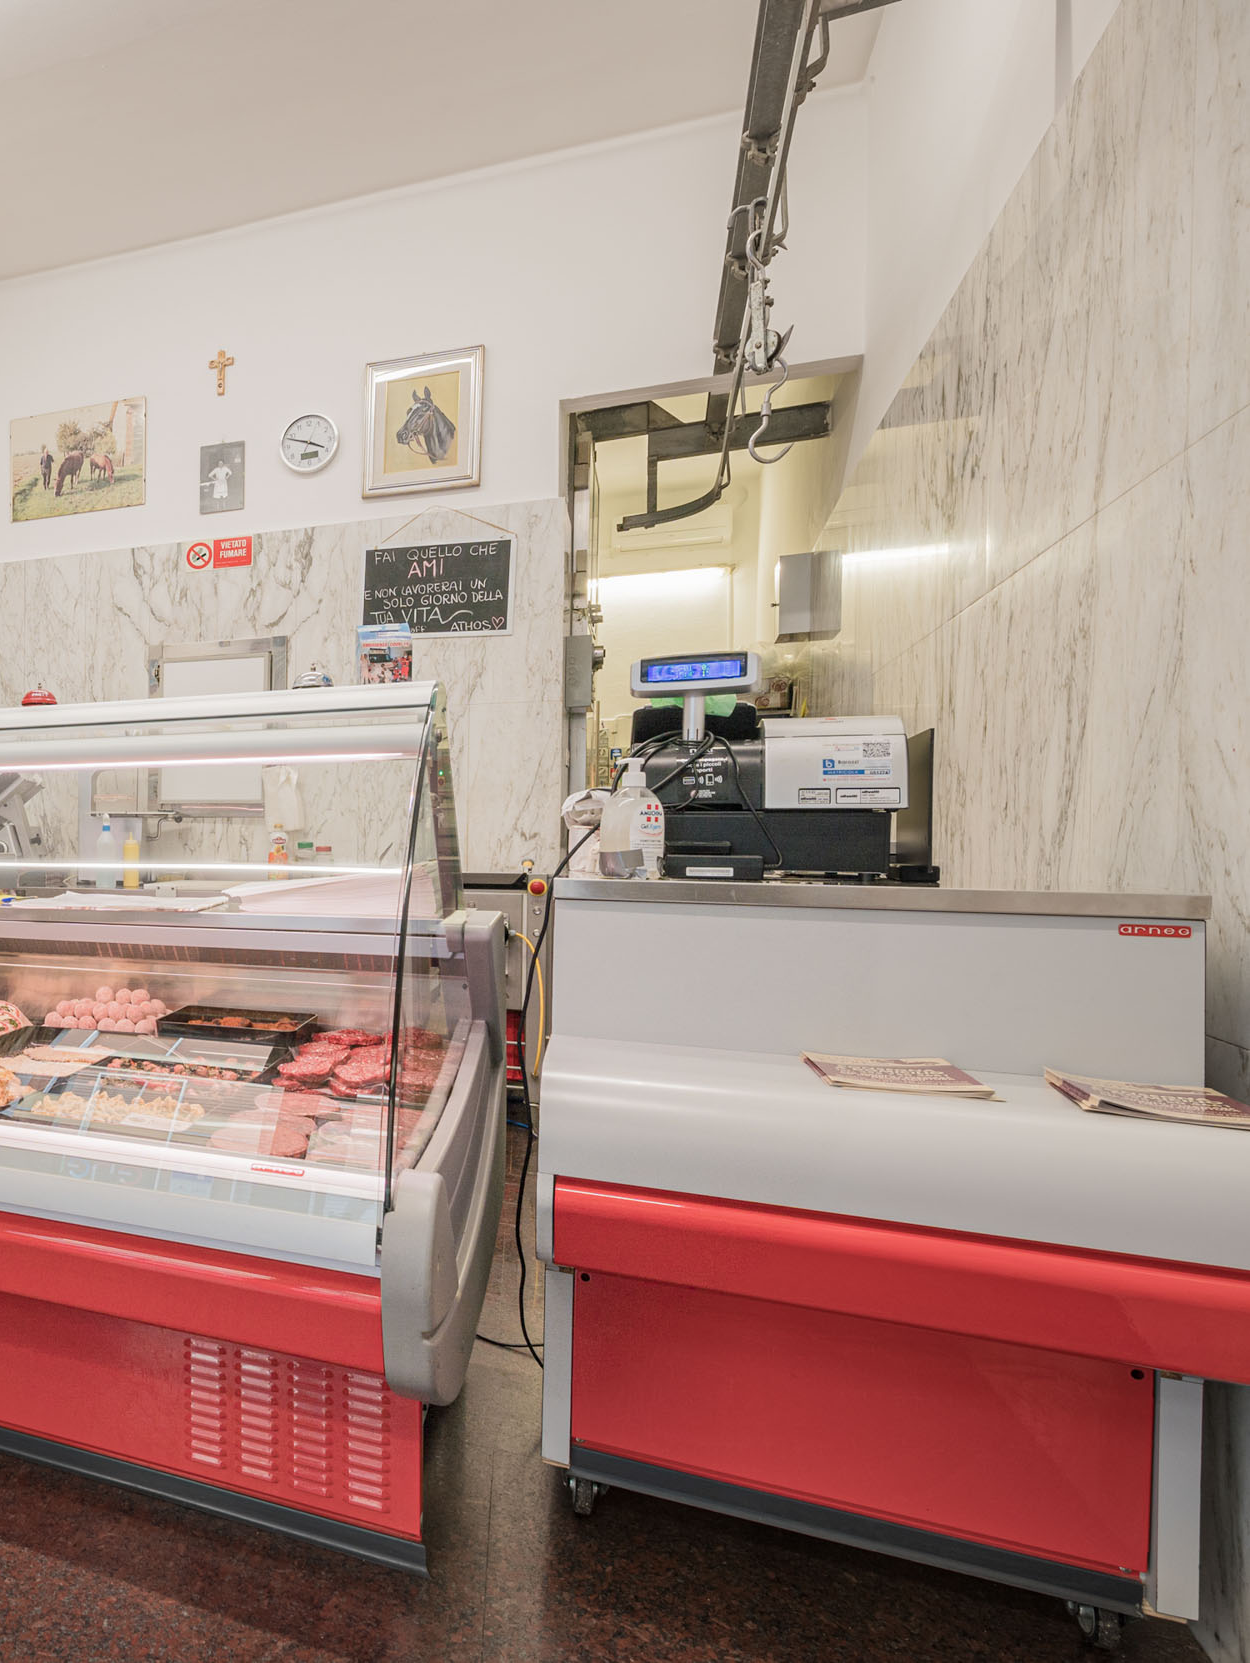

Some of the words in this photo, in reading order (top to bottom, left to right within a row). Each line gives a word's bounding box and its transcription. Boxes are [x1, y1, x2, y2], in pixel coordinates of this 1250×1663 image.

[220, 549, 246, 558] FUMARE
[221, 540, 246, 549] VIETATO
[374, 551, 396, 565] FAI
[406, 545, 463, 561] QUELLO
[469, 542, 499, 556] CHE
[407, 558, 444, 579] AMI
[364, 590, 372, 600] E
[374, 586, 397, 599] NON
[401, 580, 463, 596] LAVORERAI
[470, 577, 487, 590] UN
[383, 597, 414, 610] SOLO
[420, 591, 468, 606] GIORNO
[472, 588, 504, 602] DELLA
[369, 610, 395, 625] TUA
[401, 606, 452, 624] VITA
[450, 619, 492, 633] ATHOS
